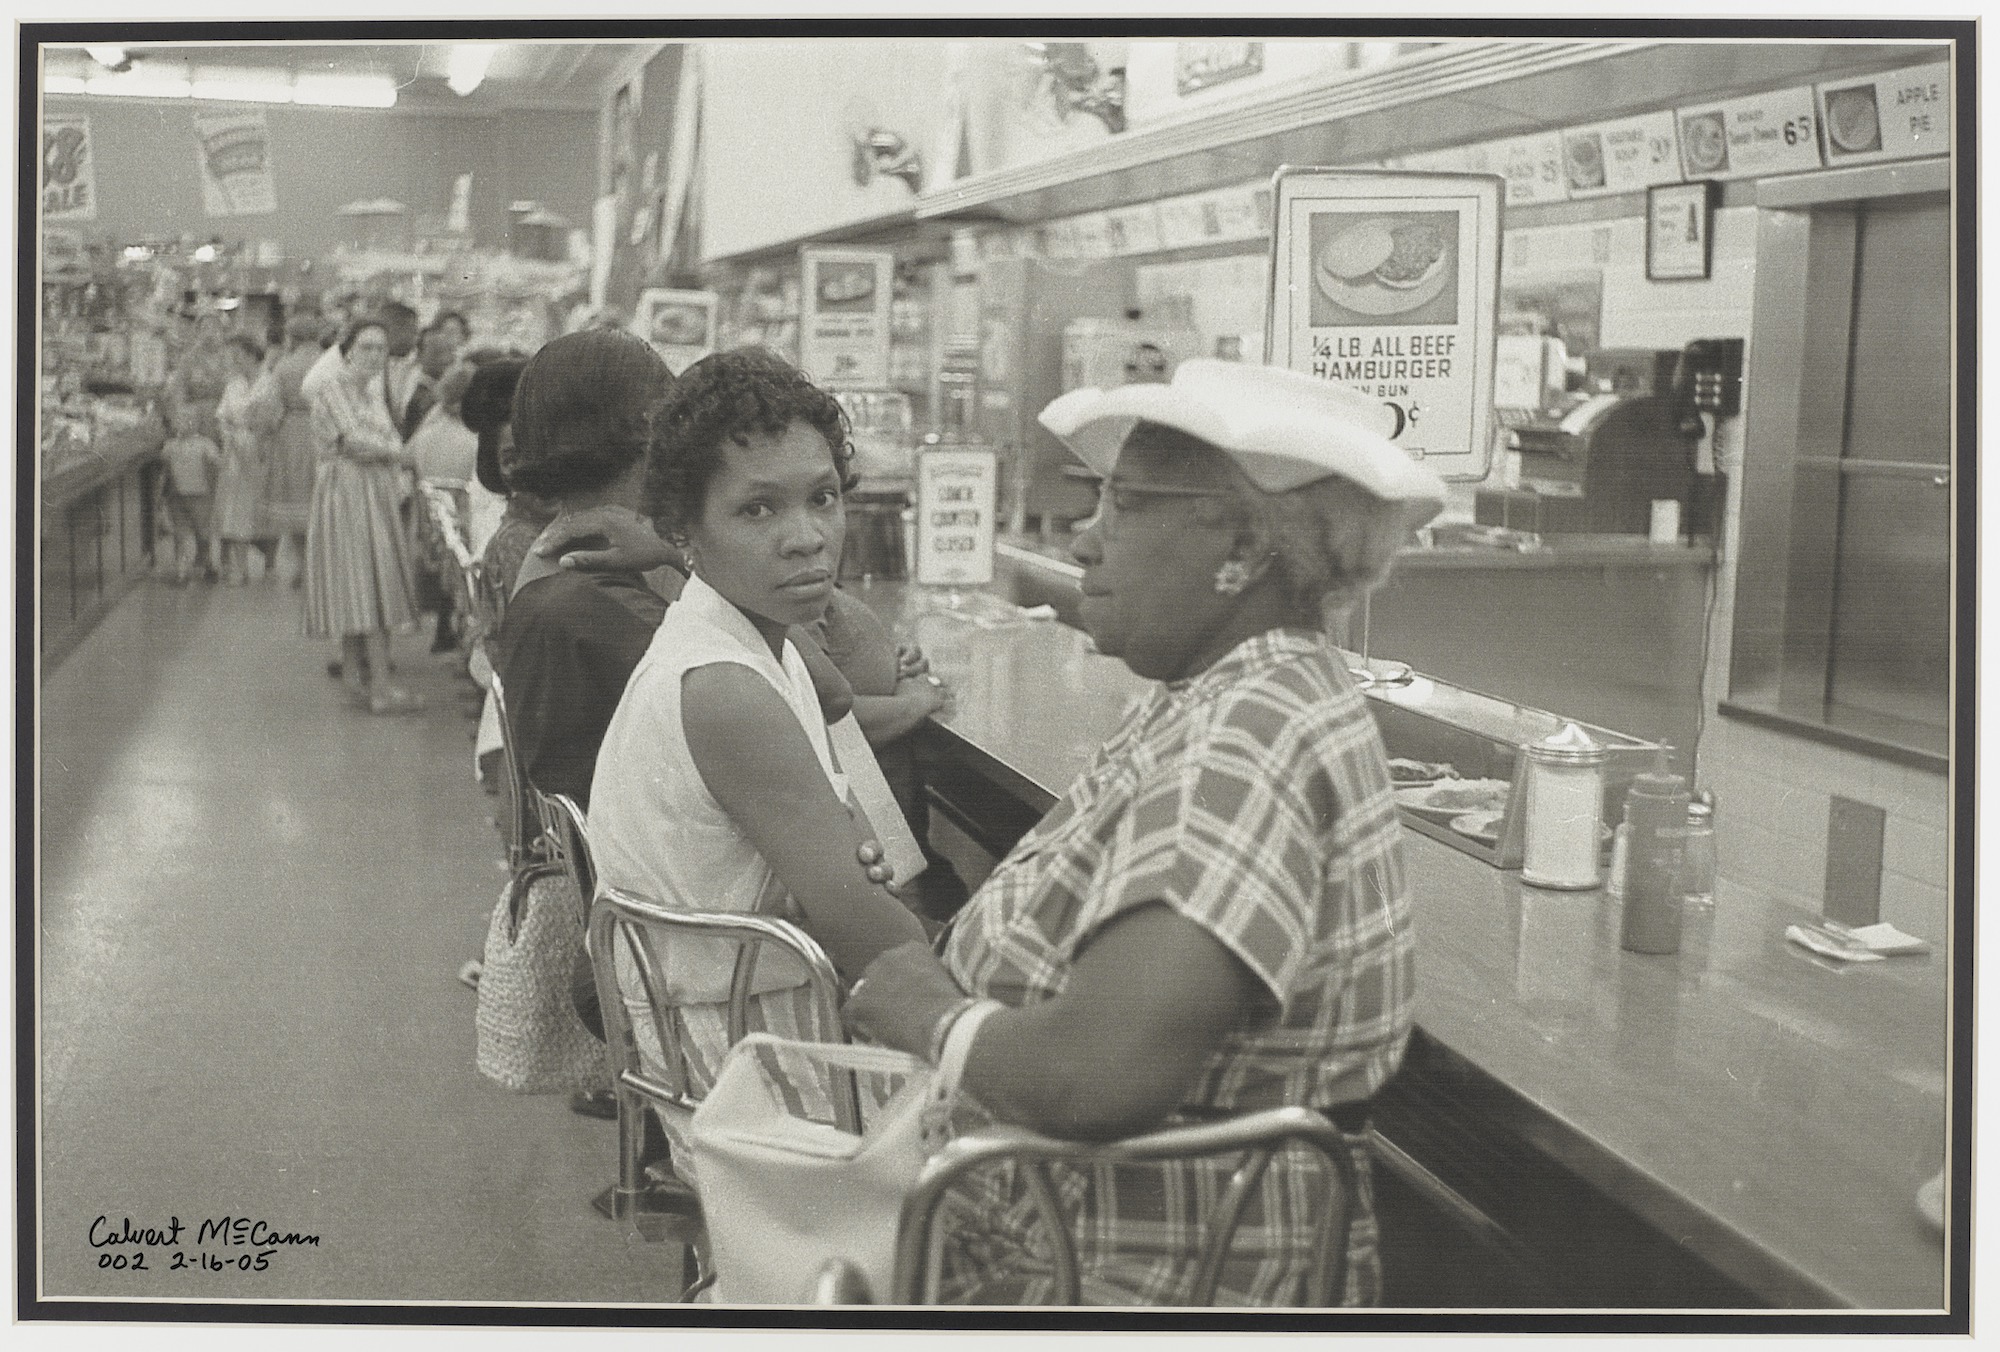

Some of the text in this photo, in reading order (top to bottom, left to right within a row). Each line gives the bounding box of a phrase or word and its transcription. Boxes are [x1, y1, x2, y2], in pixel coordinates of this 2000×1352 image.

[1897, 83, 1940, 106] APPLE
[1783, 114, 1812, 146] 65
[1909, 114, 1932, 134] PIE
[1371, 336, 1405, 357] ALL
[1410, 334, 1456, 356] BEEF
[1312, 358, 1451, 380] HAMBURGER
[1377, 384, 1409, 398] BUN
[88, 1215, 186, 1248] Calvert
[97, 1249, 278, 1272] 002 2-16-05
